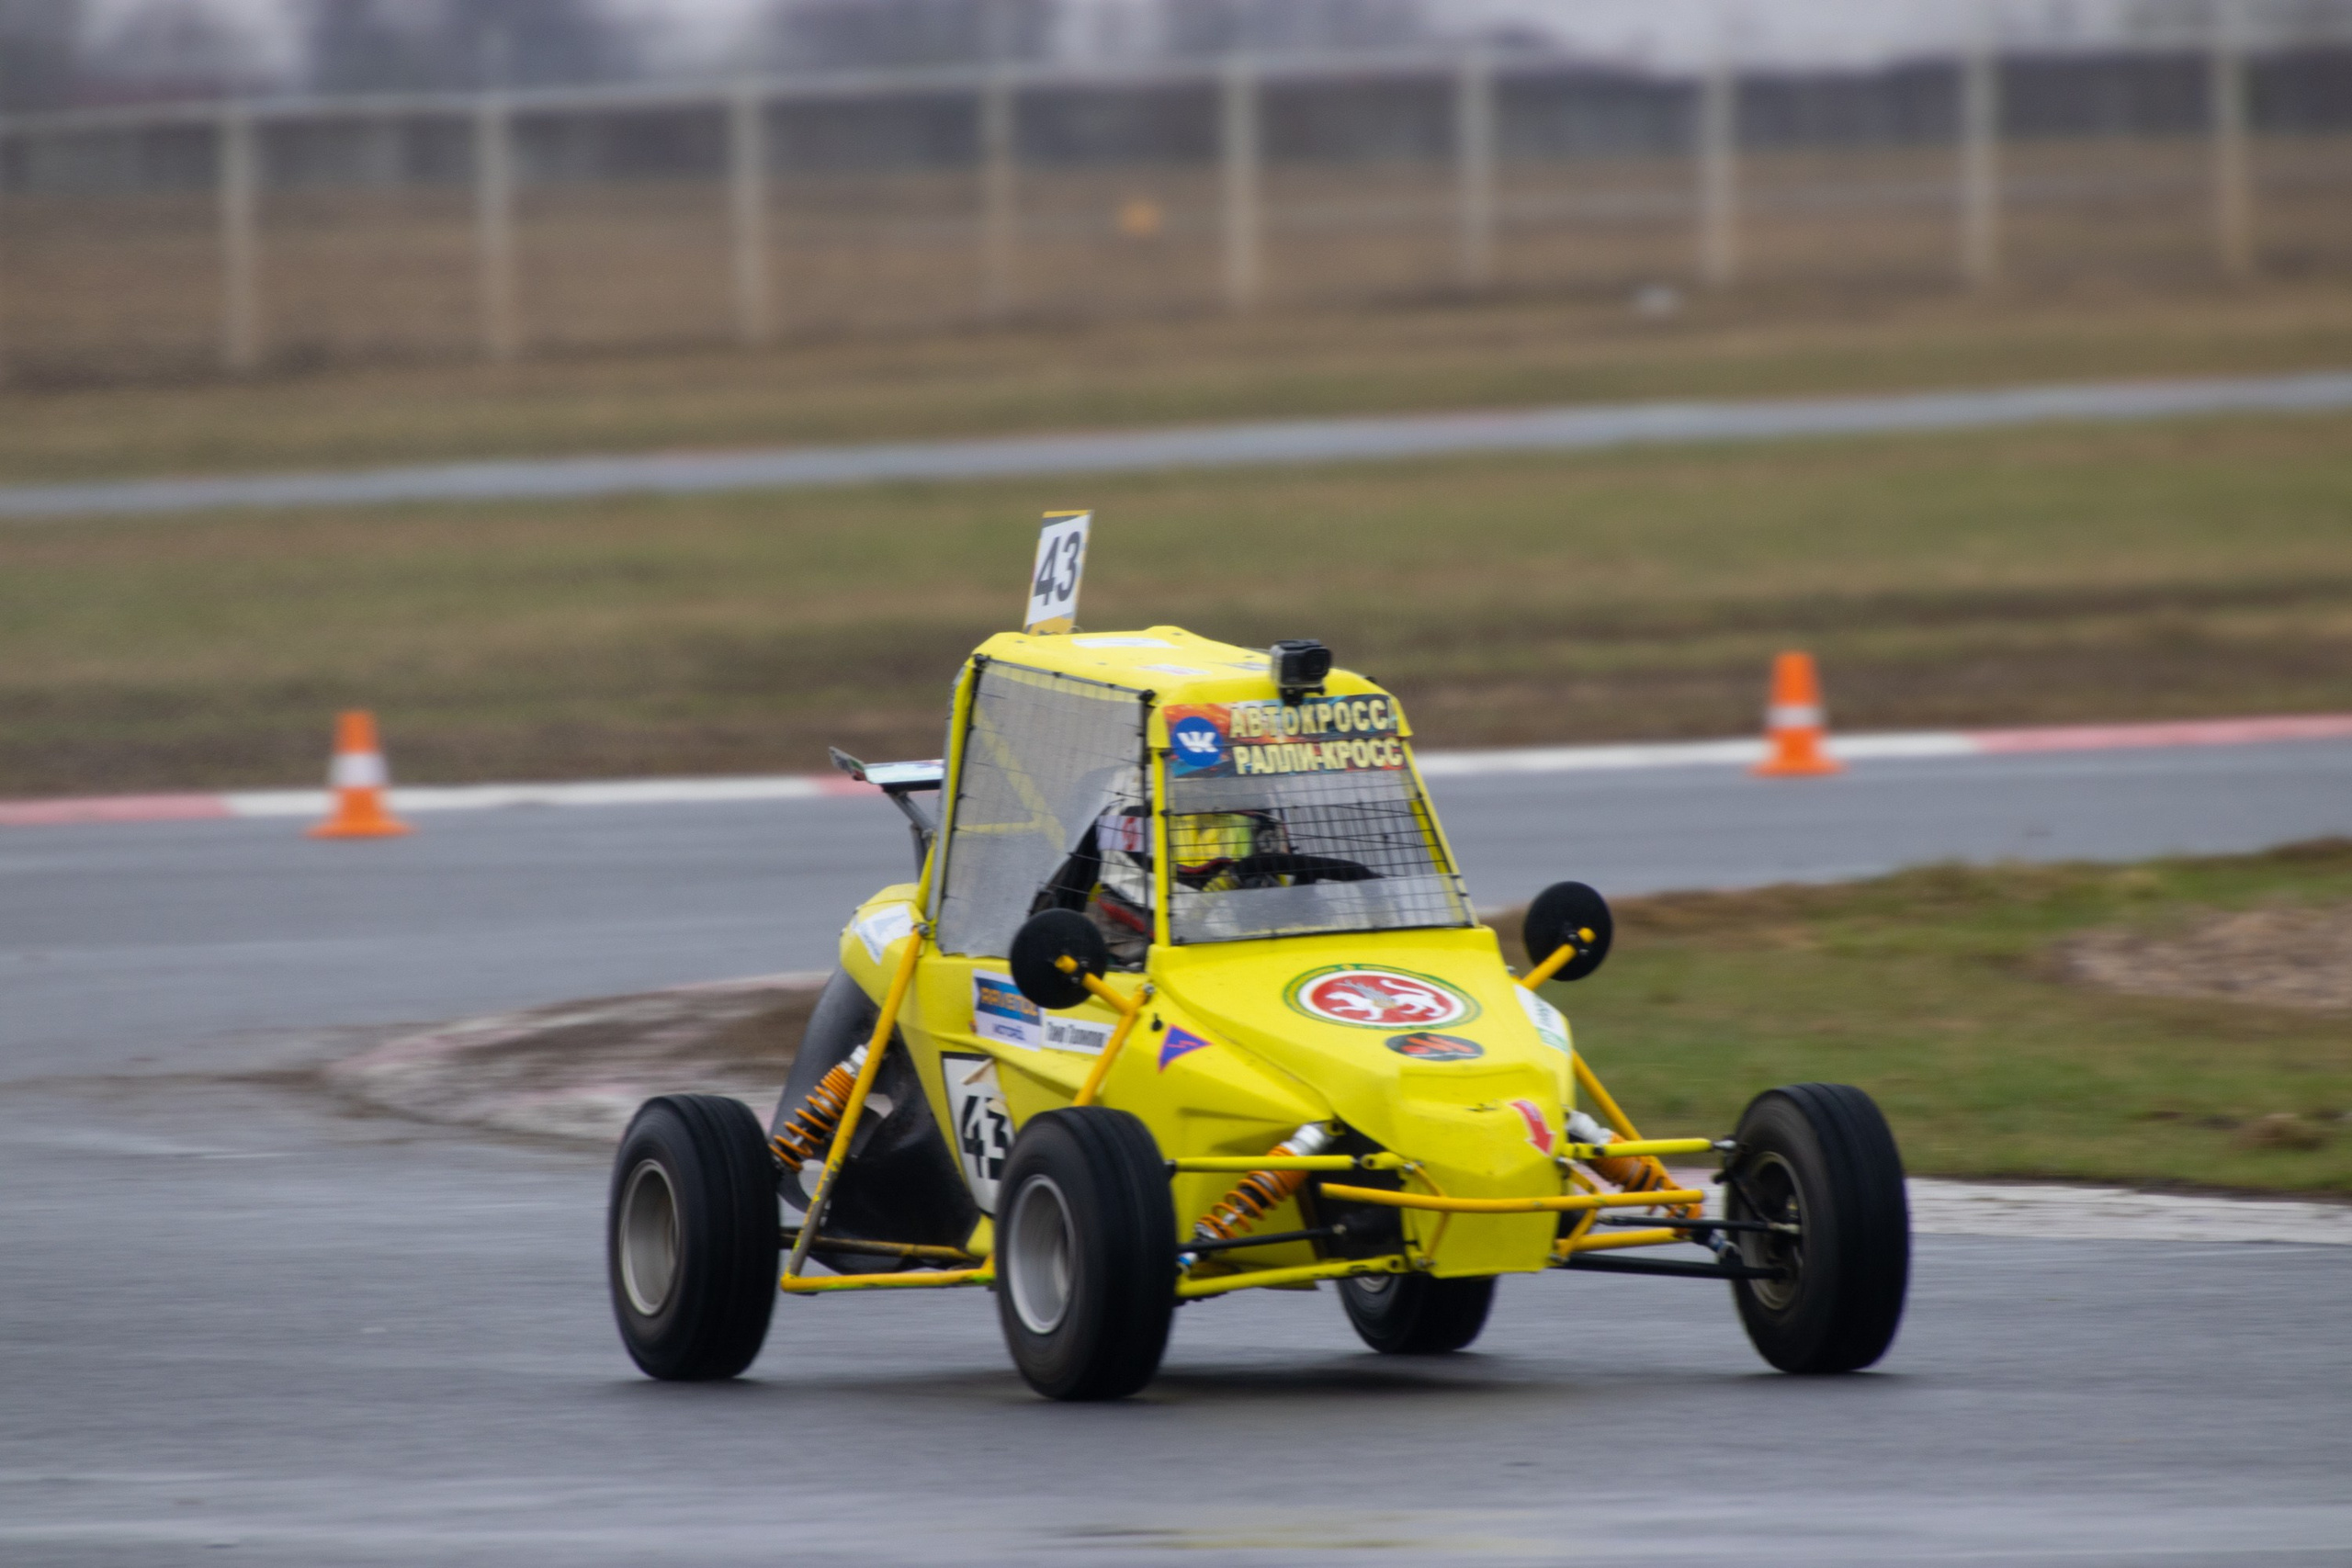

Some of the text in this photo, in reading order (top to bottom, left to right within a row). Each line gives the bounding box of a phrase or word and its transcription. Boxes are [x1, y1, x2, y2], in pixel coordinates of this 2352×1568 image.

[1034, 531, 1081, 606] 43
[1232, 738, 1403, 775] РАЛЛИ-КРОСС
[961, 1095, 1009, 1181] 43
